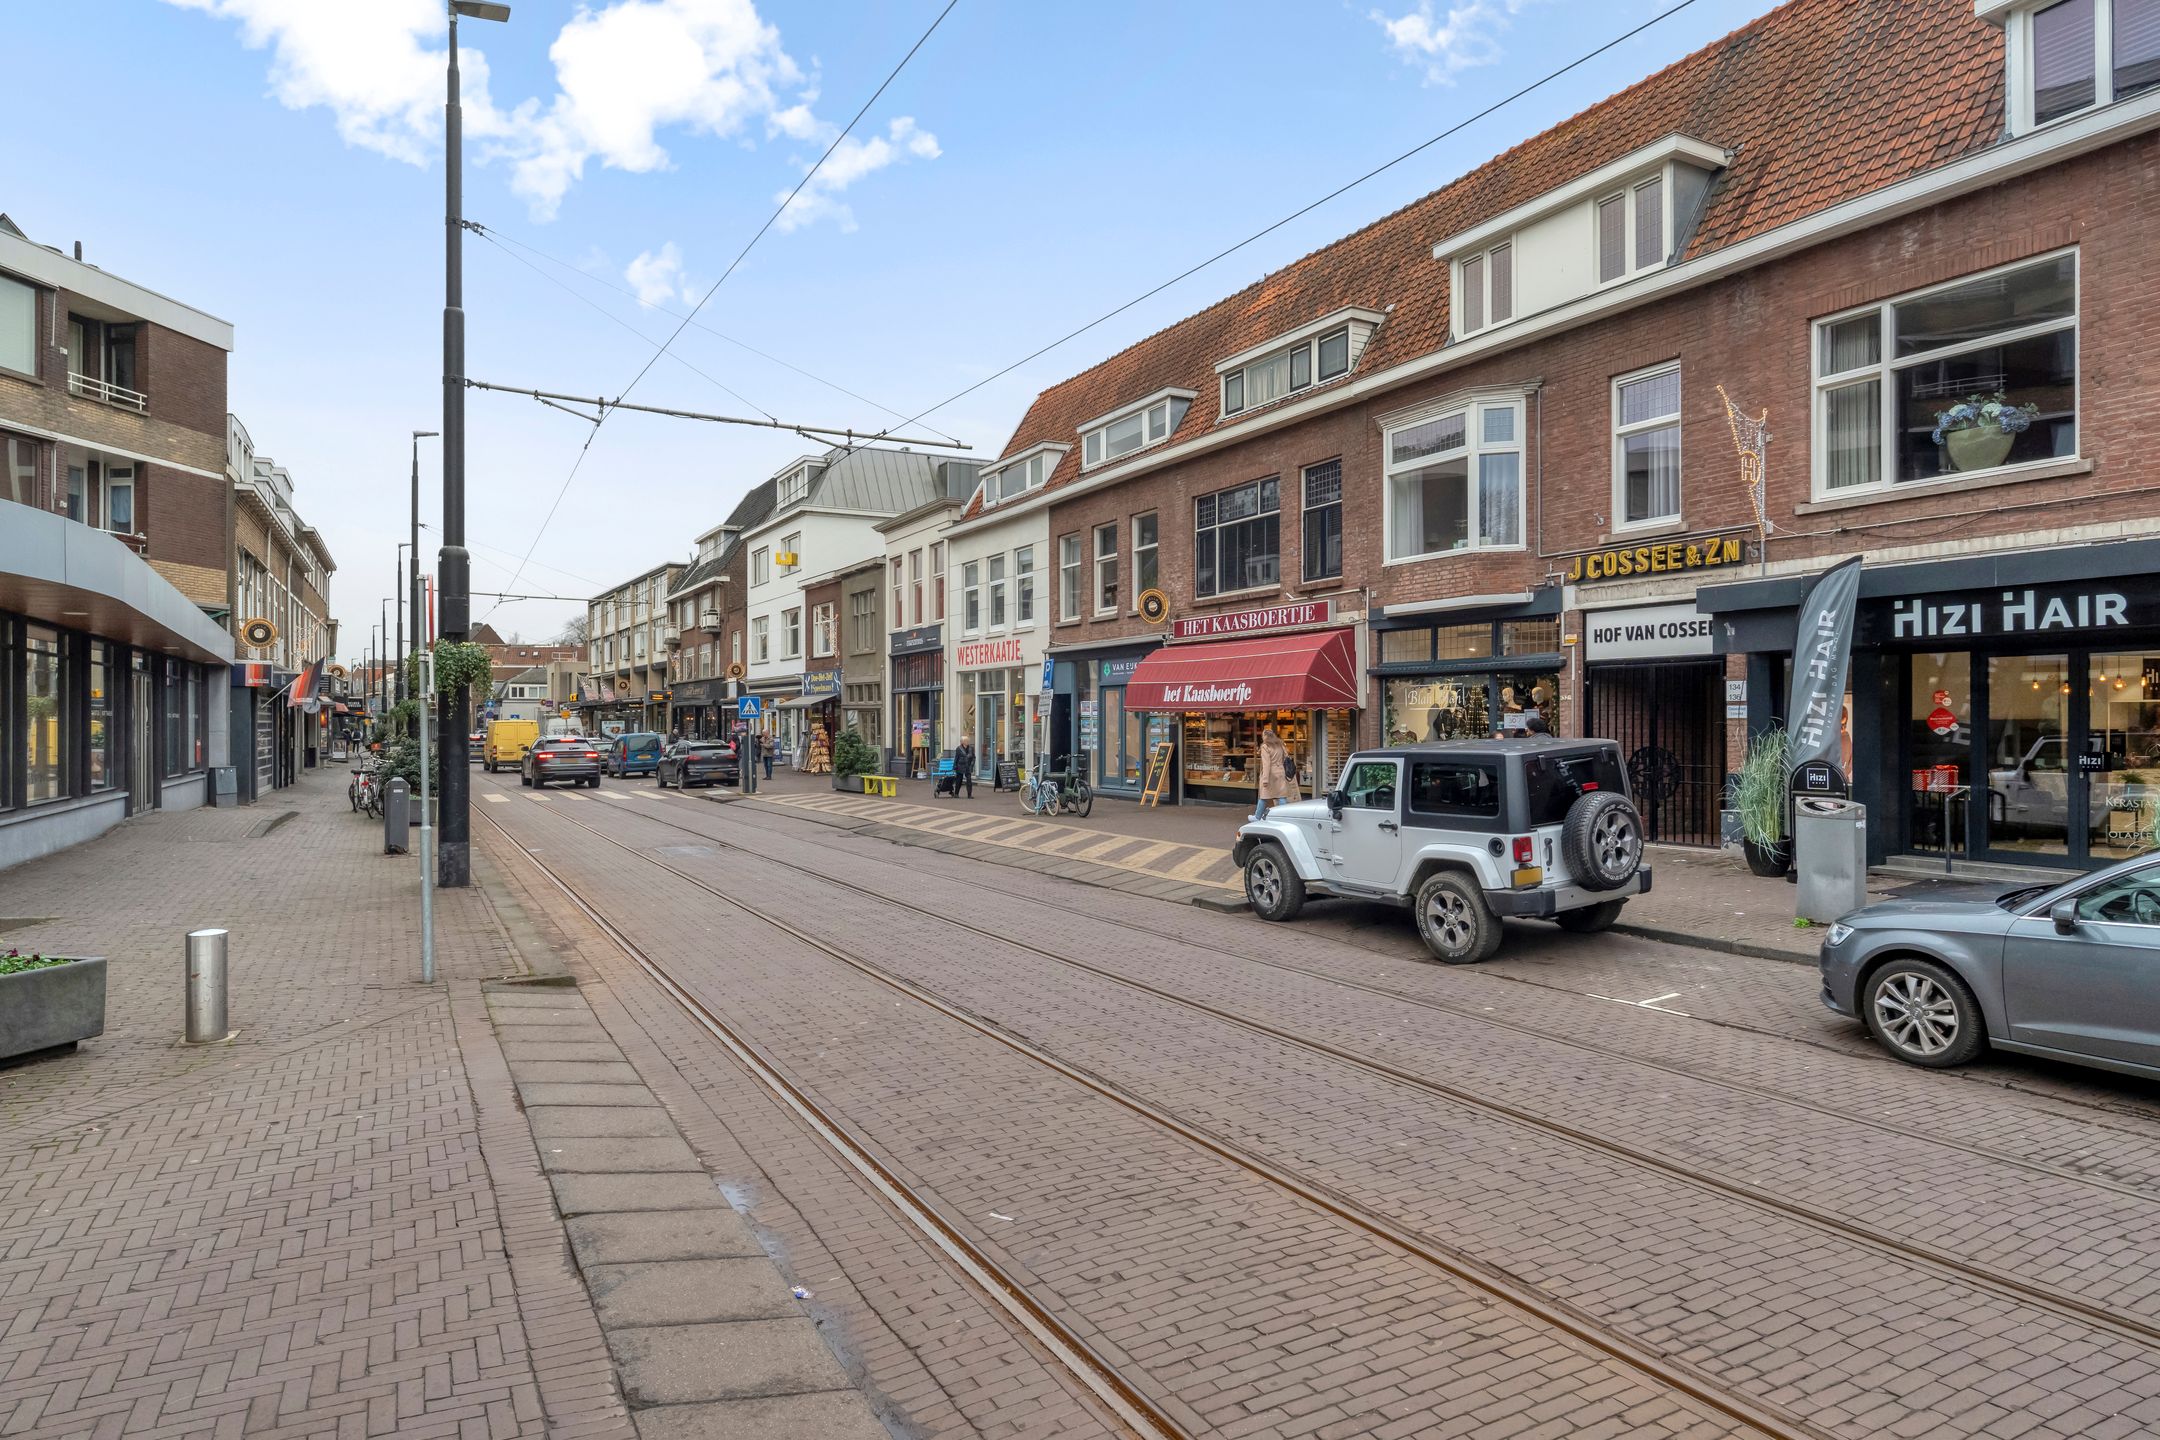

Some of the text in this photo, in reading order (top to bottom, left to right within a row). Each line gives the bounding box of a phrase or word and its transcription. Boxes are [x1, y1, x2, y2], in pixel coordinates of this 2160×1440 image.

[1568, 556, 1582, 581] J
[1586, 543, 1683, 579] COSSEE
[1686, 545, 1702, 567] &
[1183, 604, 1316, 636] HET KAASBOERTJE
[1894, 590, 2130, 638] HIZI HAIR
[1594, 627, 1622, 643] HOF
[1625, 624, 1655, 642] VAN
[957, 639, 1021, 666] WESTERKAATJE
[1045, 663, 1051, 677] P
[1801, 609, 1837, 748] HIZI HAIR
[1163, 682, 1252, 706] het Kaasboertje
[2079, 755, 2102, 765] HIZI
[1810, 773, 1826, 782] HIZI
